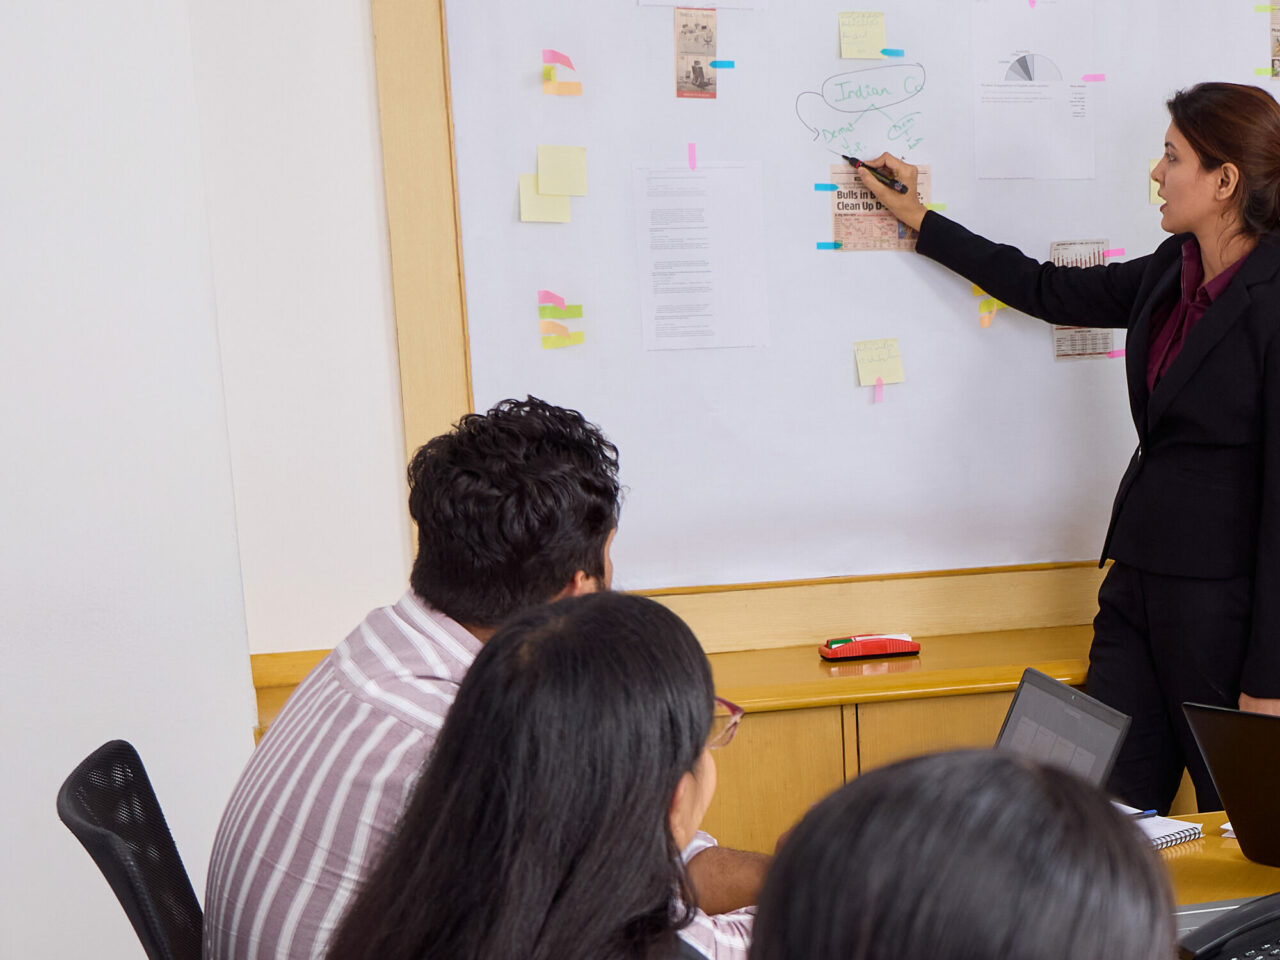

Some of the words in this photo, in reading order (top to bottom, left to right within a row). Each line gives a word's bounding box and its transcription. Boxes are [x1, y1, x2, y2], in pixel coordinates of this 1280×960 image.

[835, 81, 891, 102] Indian
[836, 190, 858, 200] Bulls
[860, 190, 869, 200] in
[836, 201, 860, 211] Clean
[862, 201, 874, 212] Up
